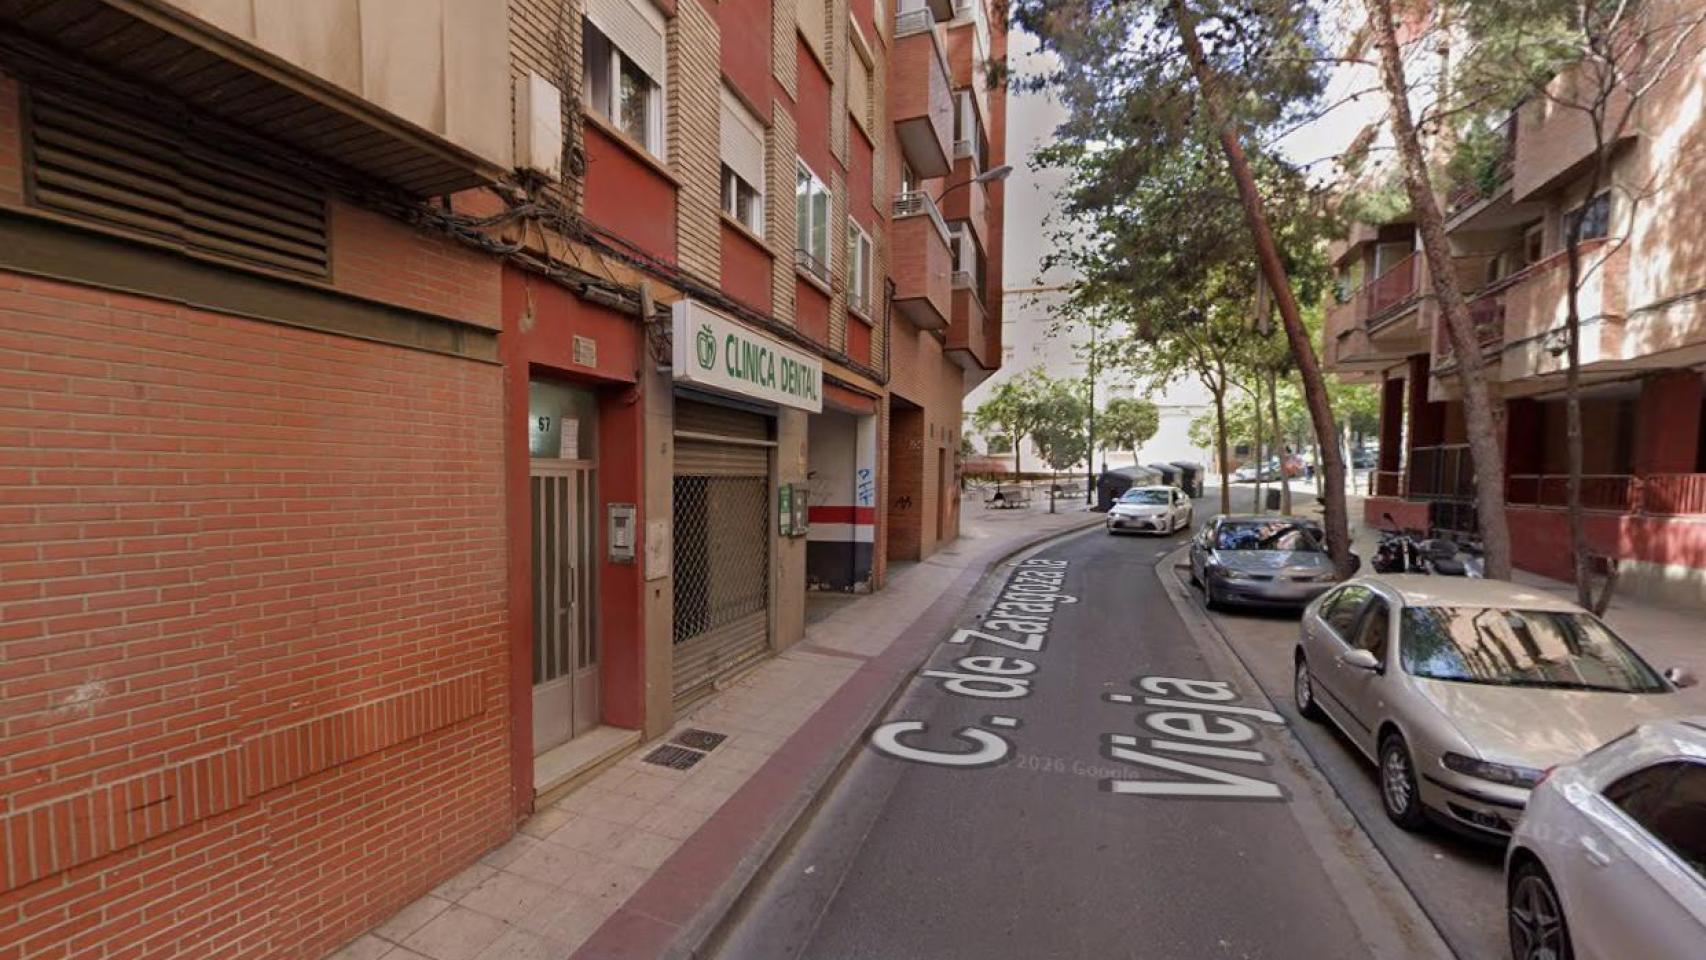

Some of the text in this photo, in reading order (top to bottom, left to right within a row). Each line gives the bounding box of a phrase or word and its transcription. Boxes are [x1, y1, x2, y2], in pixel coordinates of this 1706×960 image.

[725, 333, 818, 401] CLINICA DENTAL
[538, 416, 551, 432] 67
